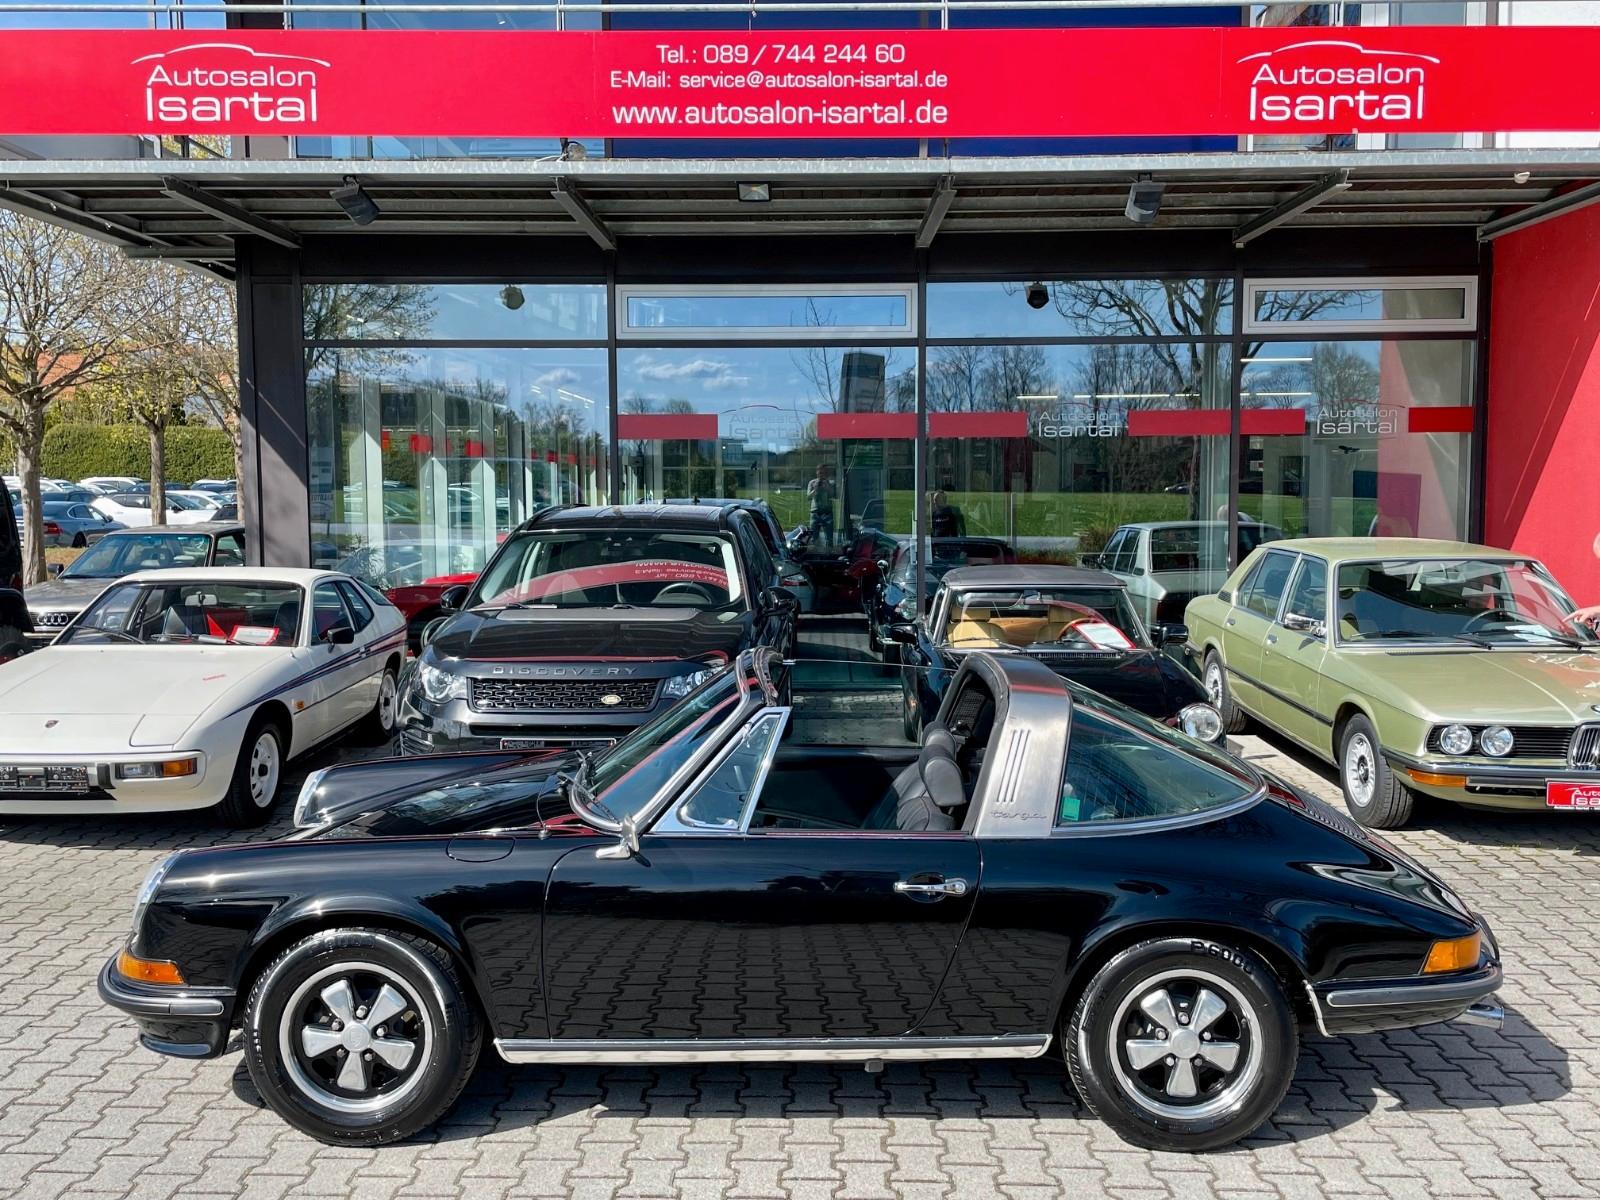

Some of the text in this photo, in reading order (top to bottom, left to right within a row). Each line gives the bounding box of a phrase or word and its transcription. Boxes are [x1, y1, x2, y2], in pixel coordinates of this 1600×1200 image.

[656, 45, 697, 63] Tel.:
[823, 45, 867, 63] 244
[875, 45, 905, 63] 60
[146, 64, 316, 86] Autosalon
[610, 71, 948, 88] E-Mail: service@autosalon-isartal.de
[1252, 62, 1424, 85] Autosalon
[146, 87, 317, 121] Isartal
[1249, 85, 1424, 121] Isartal
[612, 100, 948, 124] www.autosalon-isartal.de
[1040, 411, 1118, 421] Autosalon
[1318, 406, 1398, 417] Autosalon
[1038, 421, 1119, 437] Isartal
[1316, 417, 1398, 434] Isartal
[492, 666, 638, 676] DISCOVERY
